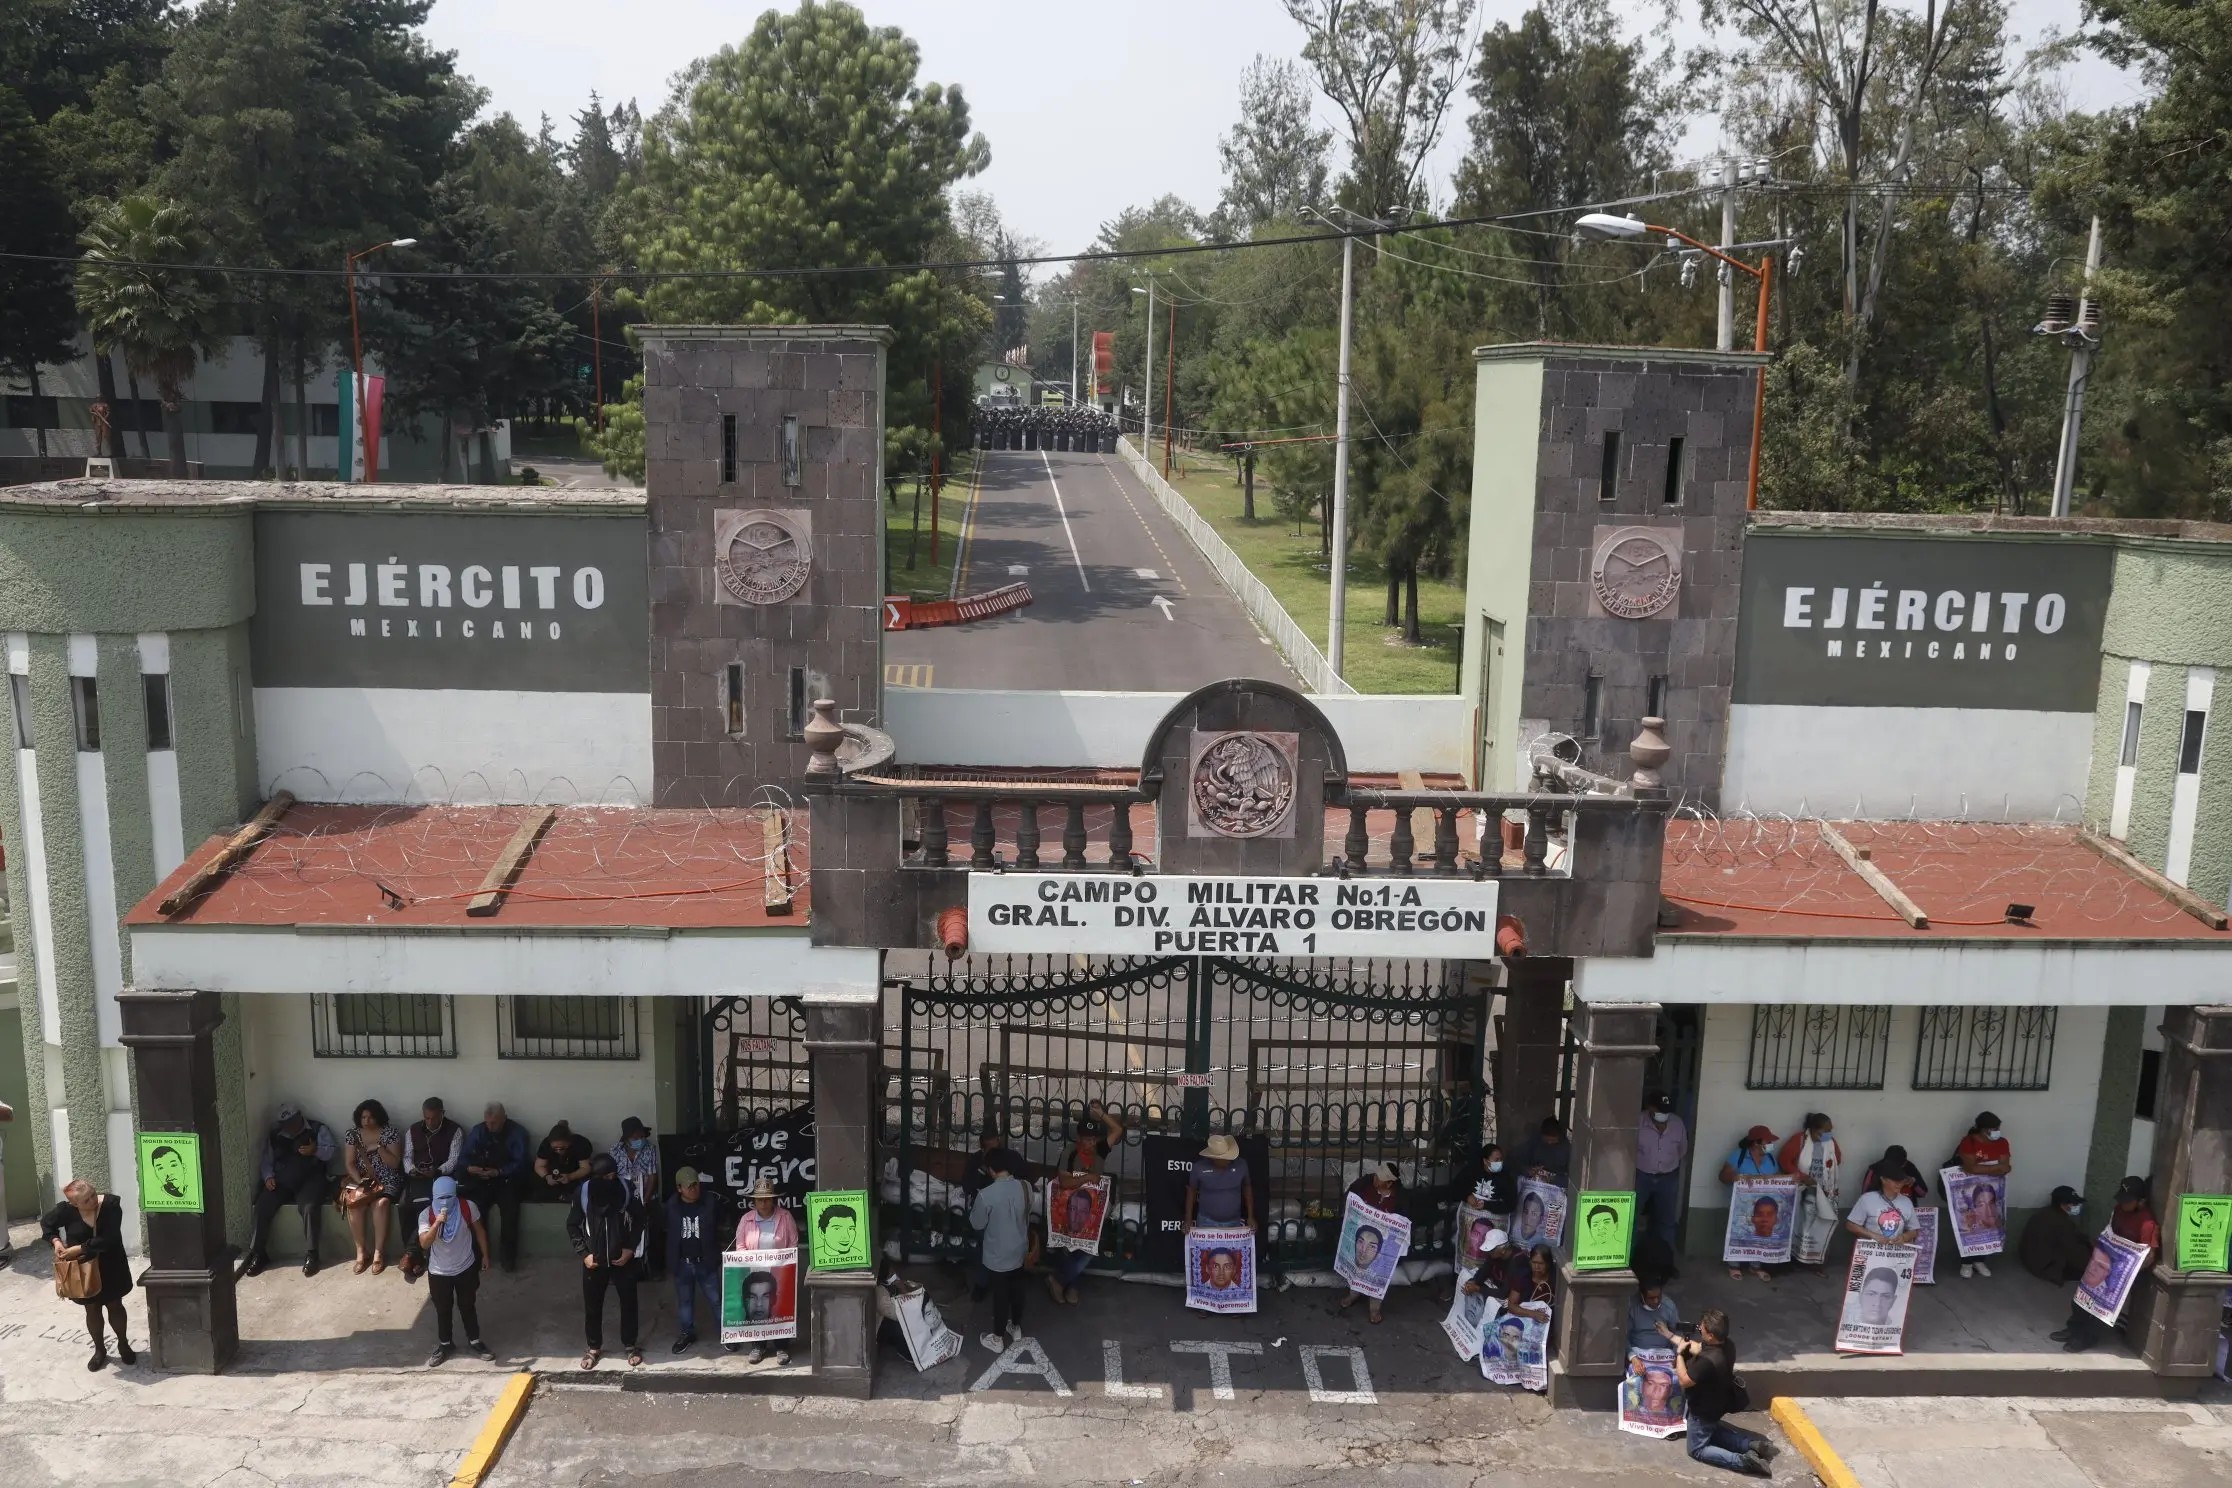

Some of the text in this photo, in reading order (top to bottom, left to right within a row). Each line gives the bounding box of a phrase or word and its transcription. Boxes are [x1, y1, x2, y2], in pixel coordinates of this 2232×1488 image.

[300, 556, 604, 609] EJÉRCITO
[720, 565, 808, 602] SIEMPRE LEALES
[1595, 582, 1677, 616] SIEMPRE LEALES
[1784, 581, 2066, 634] EJÉRCITO
[350, 619, 561, 640] MEXICANO
[1828, 640, 2017, 661] MEXICANO
[1038, 880, 1157, 903] CAMPO
[1187, 883, 1319, 905] MILITAR
[987, 902, 1486, 932] GRAL. DIV. ÁLVARO OBREGÓN
[1154, 931, 1317, 954] PUERTA 1
[1167, 1159, 1193, 1172] ESTO
[1365, 1207, 1373, 1215] se
[1883, 1219, 1896, 1231] 43
[755, 1254, 763, 1262] lo
[1743, 1248, 1756, 1256] VIDA
[1900, 1268, 1913, 1280] 43
[738, 1329, 752, 1338] Vida
[761, 1326, 794, 1338] queremos!
[968, 1337, 1379, 1405] ALTO
